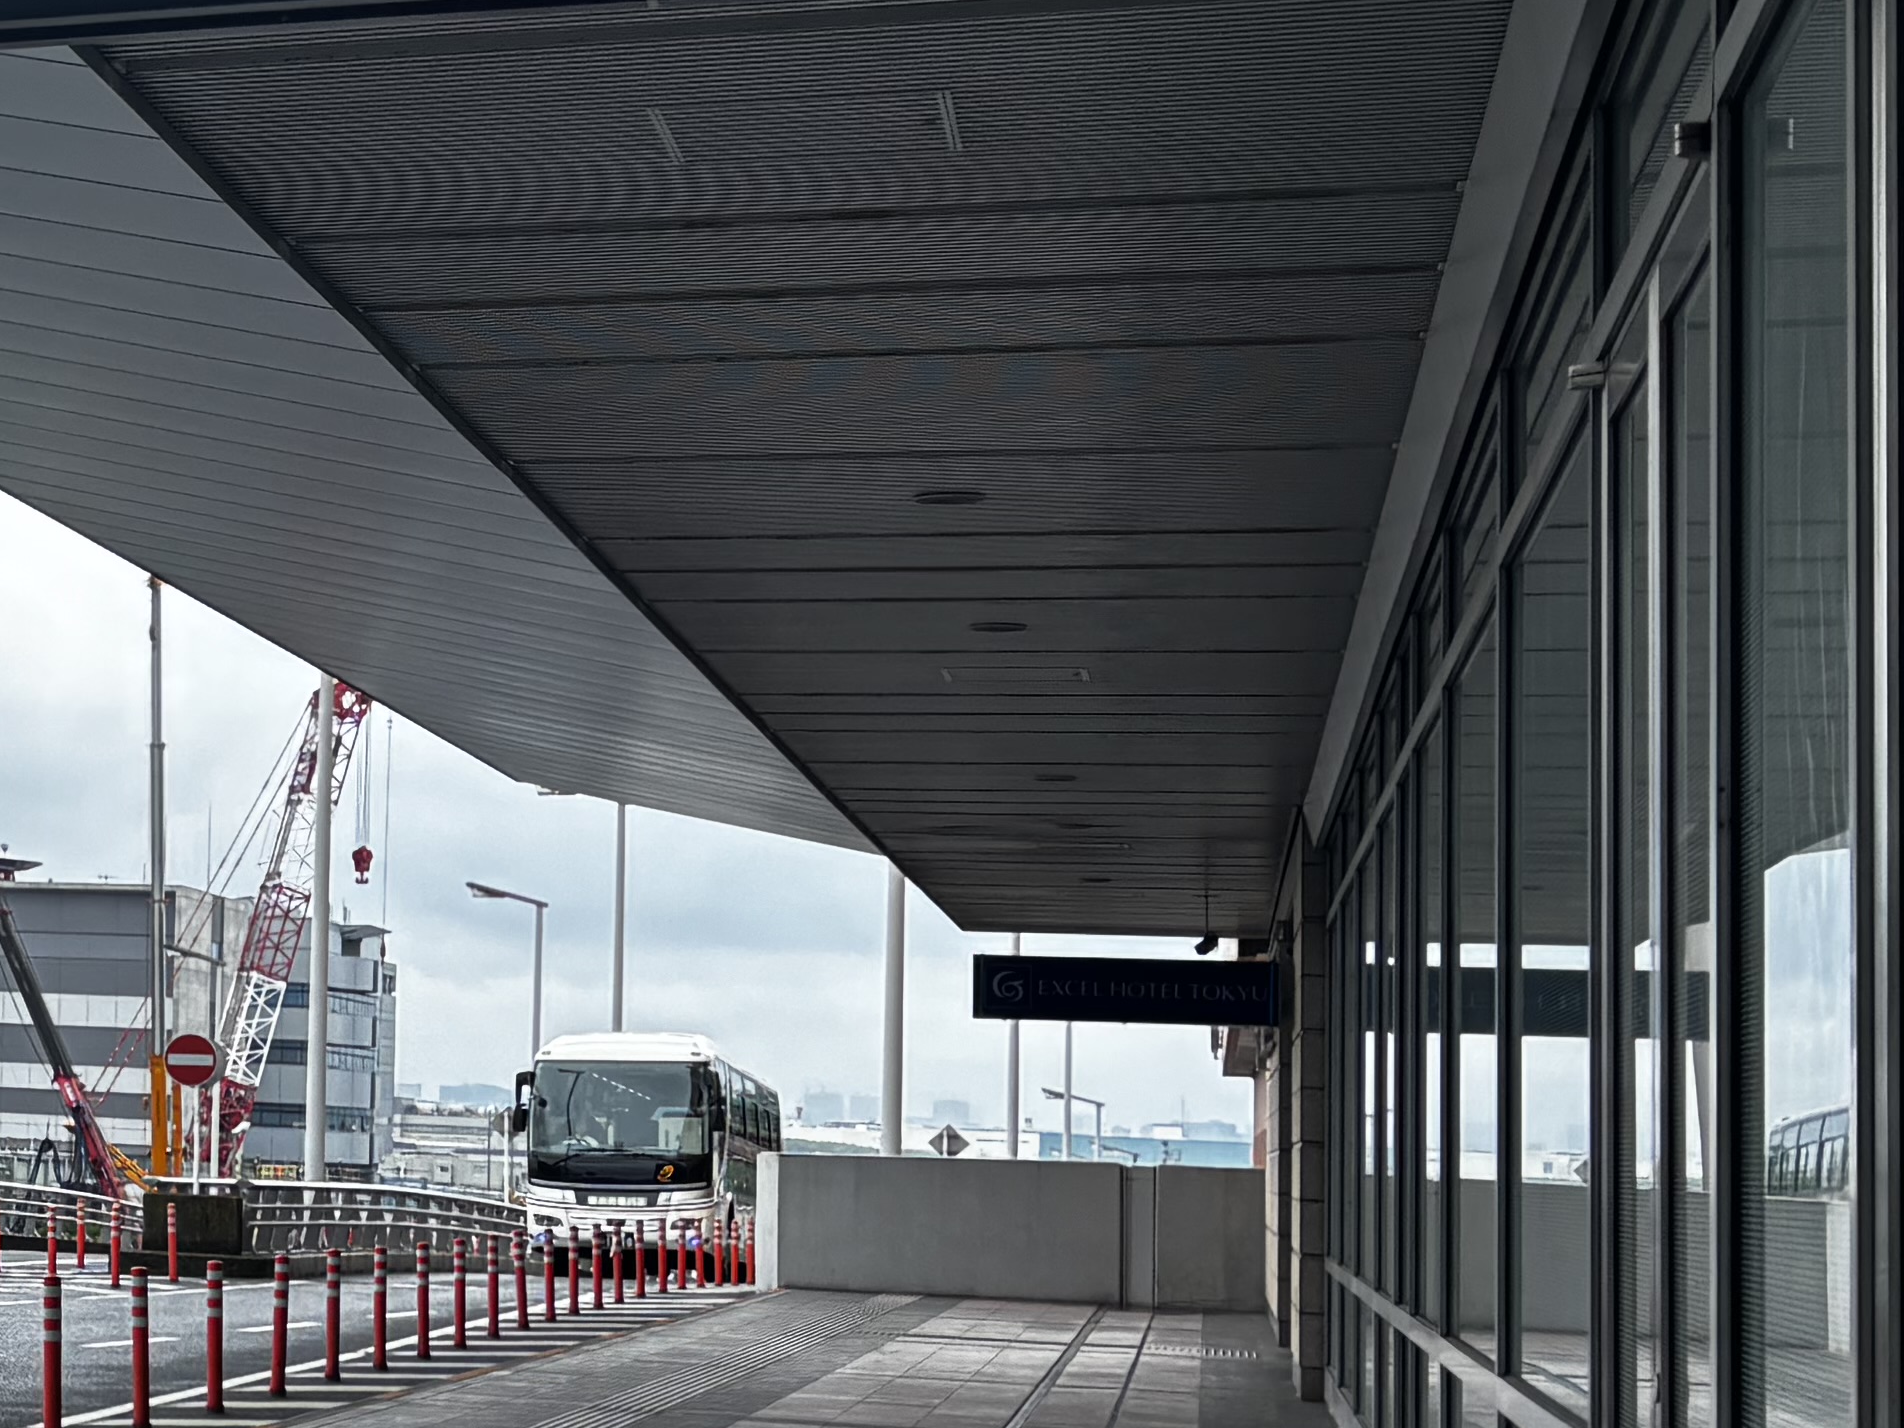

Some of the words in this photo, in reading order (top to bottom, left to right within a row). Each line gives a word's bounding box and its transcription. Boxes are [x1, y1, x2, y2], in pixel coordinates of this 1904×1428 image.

[1037, 978, 1106, 997] EXCEL
[1110, 980, 1183, 1000] HOTEL
[1188, 982, 1267, 1002] TOKYU
